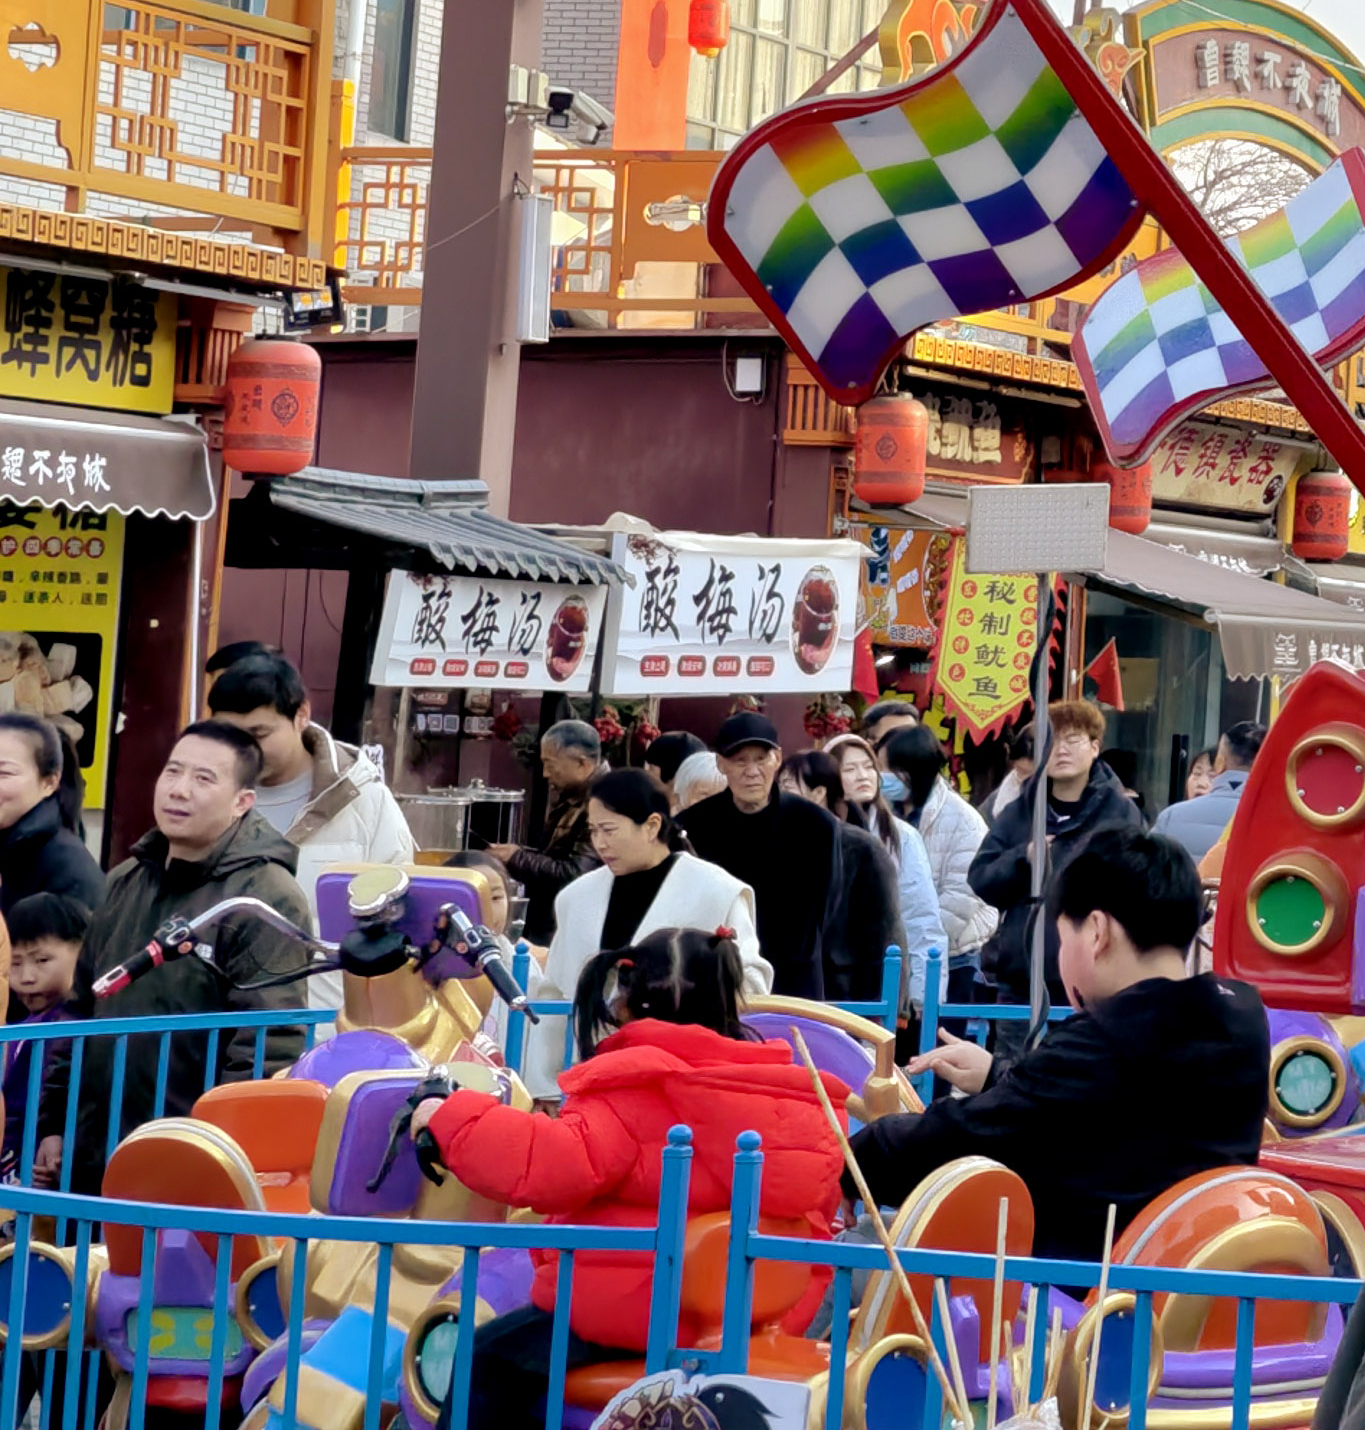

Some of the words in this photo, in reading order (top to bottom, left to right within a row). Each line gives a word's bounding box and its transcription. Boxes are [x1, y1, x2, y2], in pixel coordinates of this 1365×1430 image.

[411, 585, 542, 656] 酸梅汤
[639, 556, 785, 646] 酸梅汤
[968, 580, 1017, 700] 秘制鱿鱼
